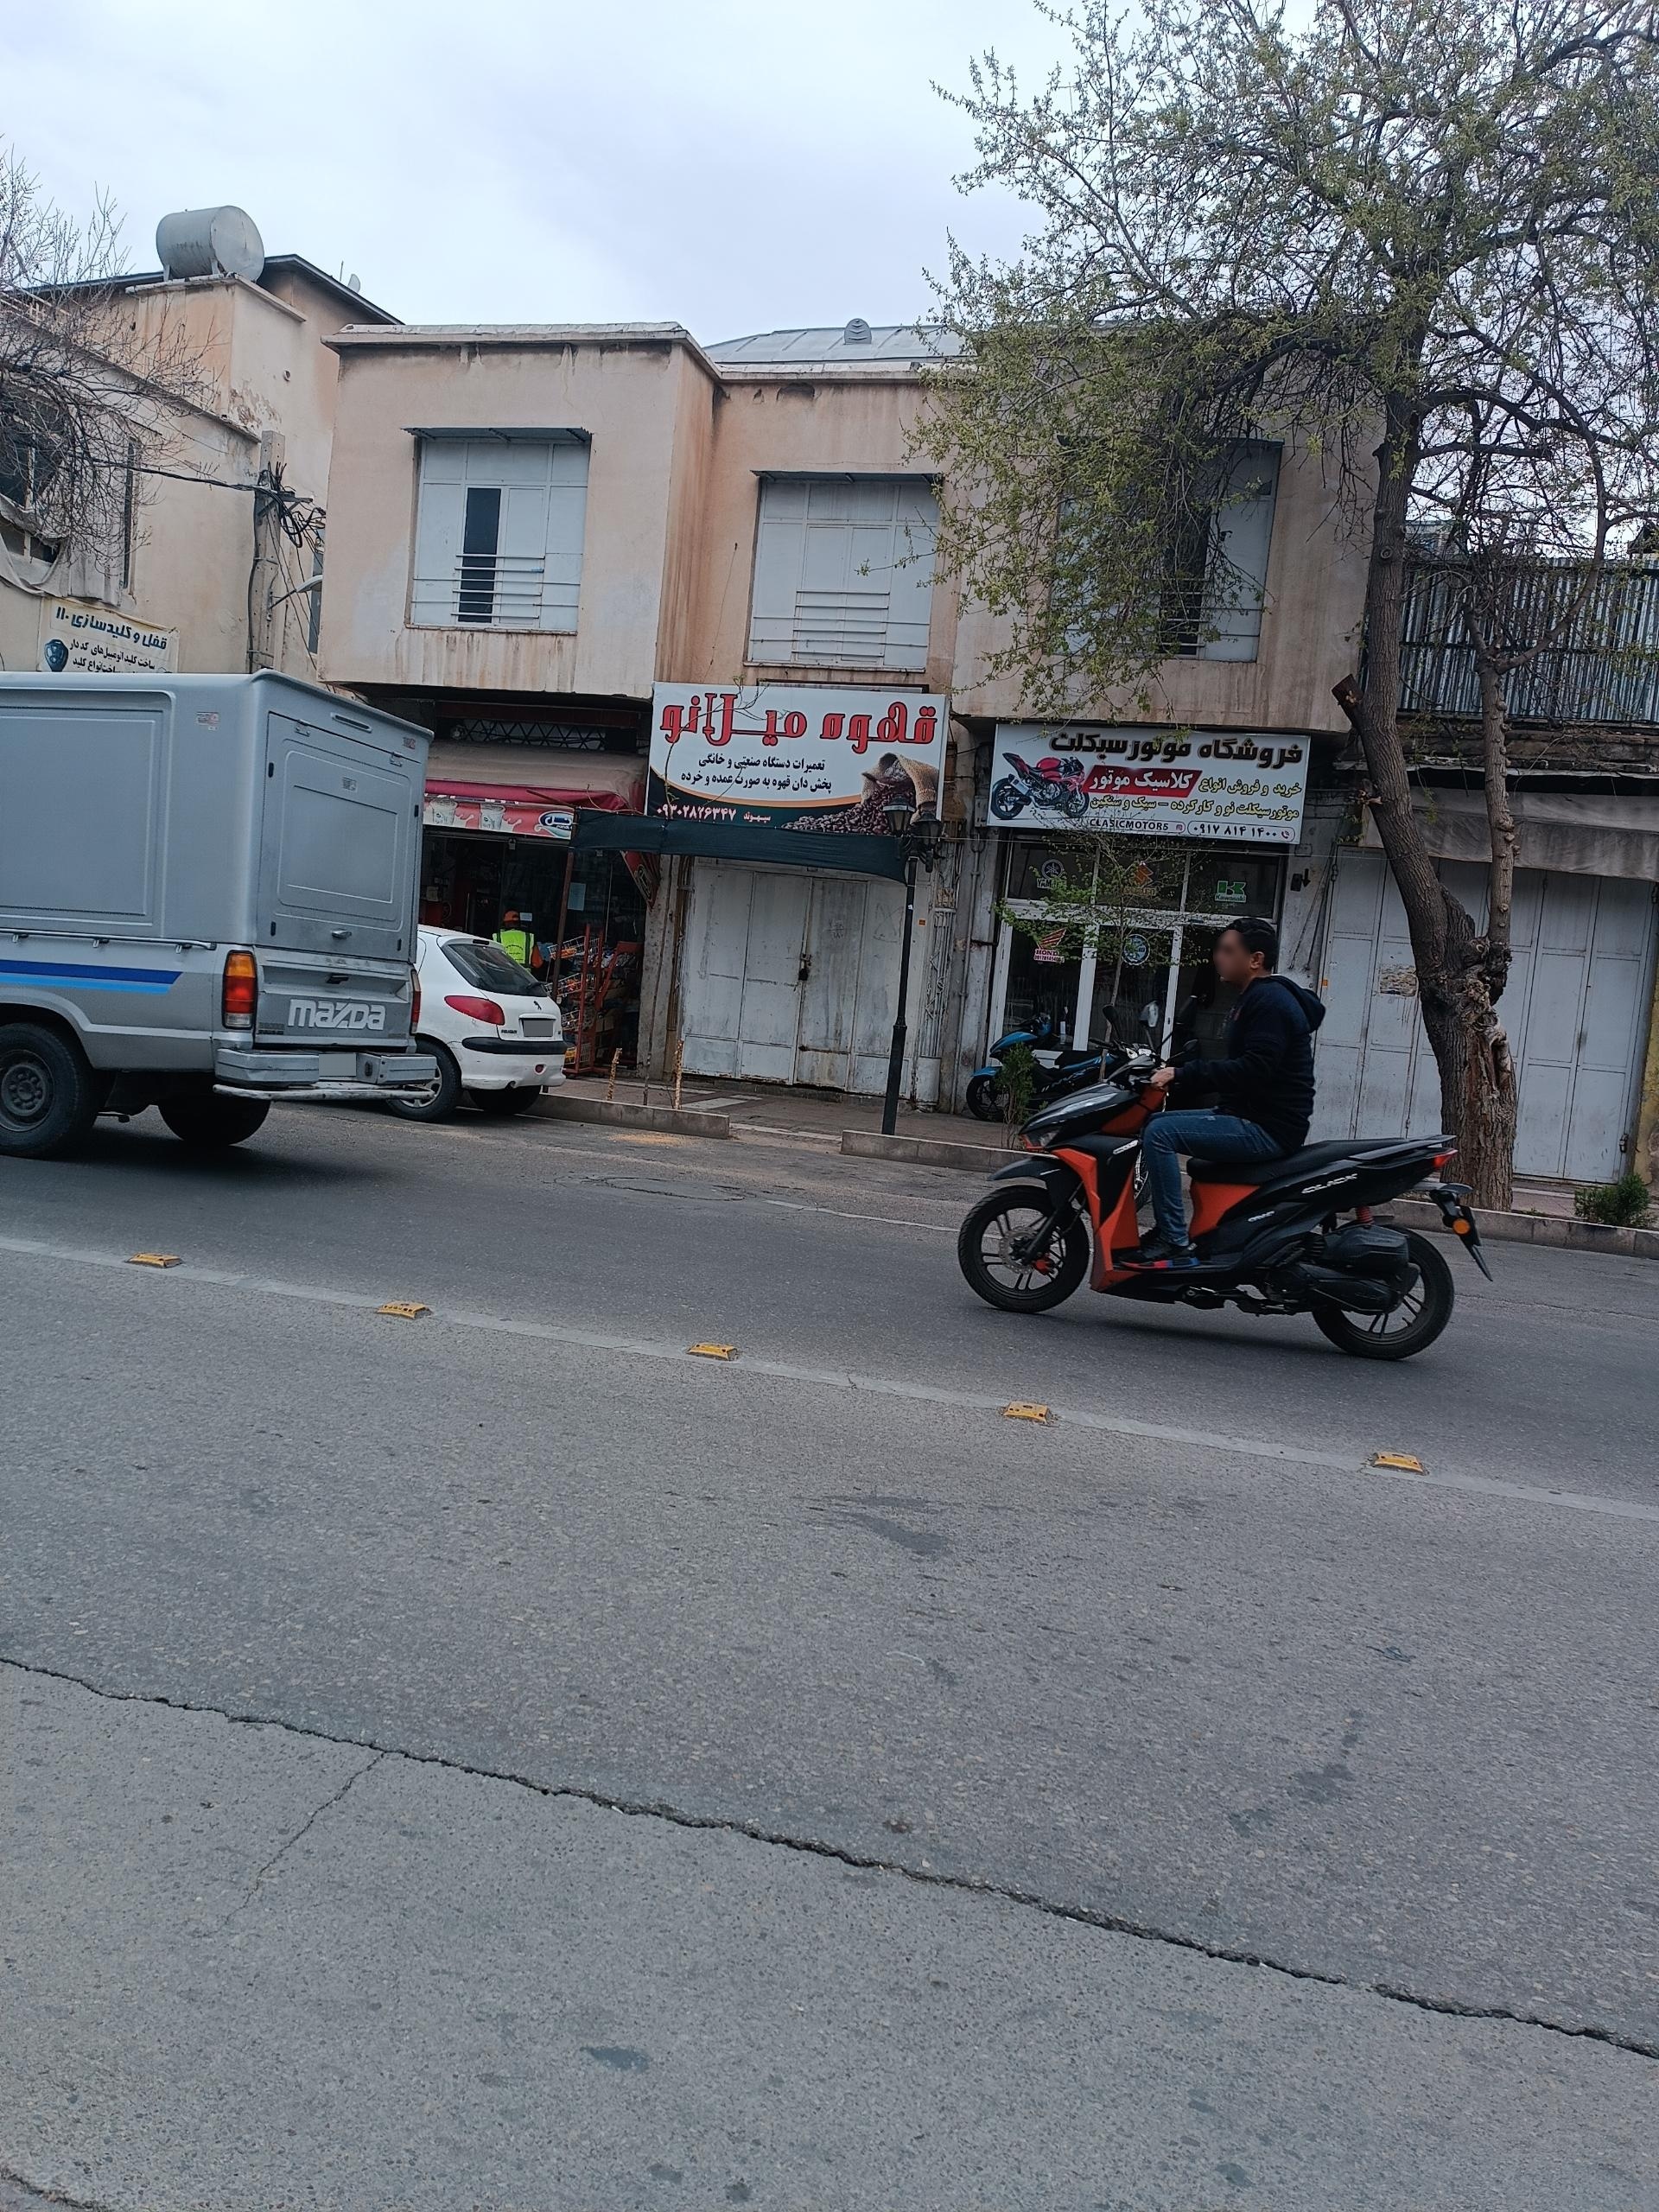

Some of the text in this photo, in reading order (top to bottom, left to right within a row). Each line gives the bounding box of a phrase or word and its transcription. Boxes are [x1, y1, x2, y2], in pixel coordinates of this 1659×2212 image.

[133, 632, 140, 644] و
[142, 634, 168, 650] قفل
[73, 657, 86, 669] کلید
[124, 654, 137, 666] کلید
[138, 659, 156, 670] ساخت
[660, 692, 938, 753] قهوه میلانو
[1198, 738, 1304, 771] فروشگاه
[698, 753, 825, 773] تعمیرات دستگاه صنعتی و خانگی
[681, 770, 832, 794] پخش دان قهوه به صورت عمده و خرده
[1089, 769, 1193, 791] کلاسیک موتور
[1198, 777, 1302, 798] خرید و فروش انواع
[1090, 795, 1122, 809] سنگین
[1123, 799, 1130, 810] و
[1132, 797, 1157, 810] سبک
[1224, 801, 1236, 817] نو
[1214, 804, 1223, 816] و
[1090, 818, 1169, 831] CLASICMOTORS
[1193, 823, 1277, 838] ۰۹۱۷ ۸۱۴ ۱۴۰۰
